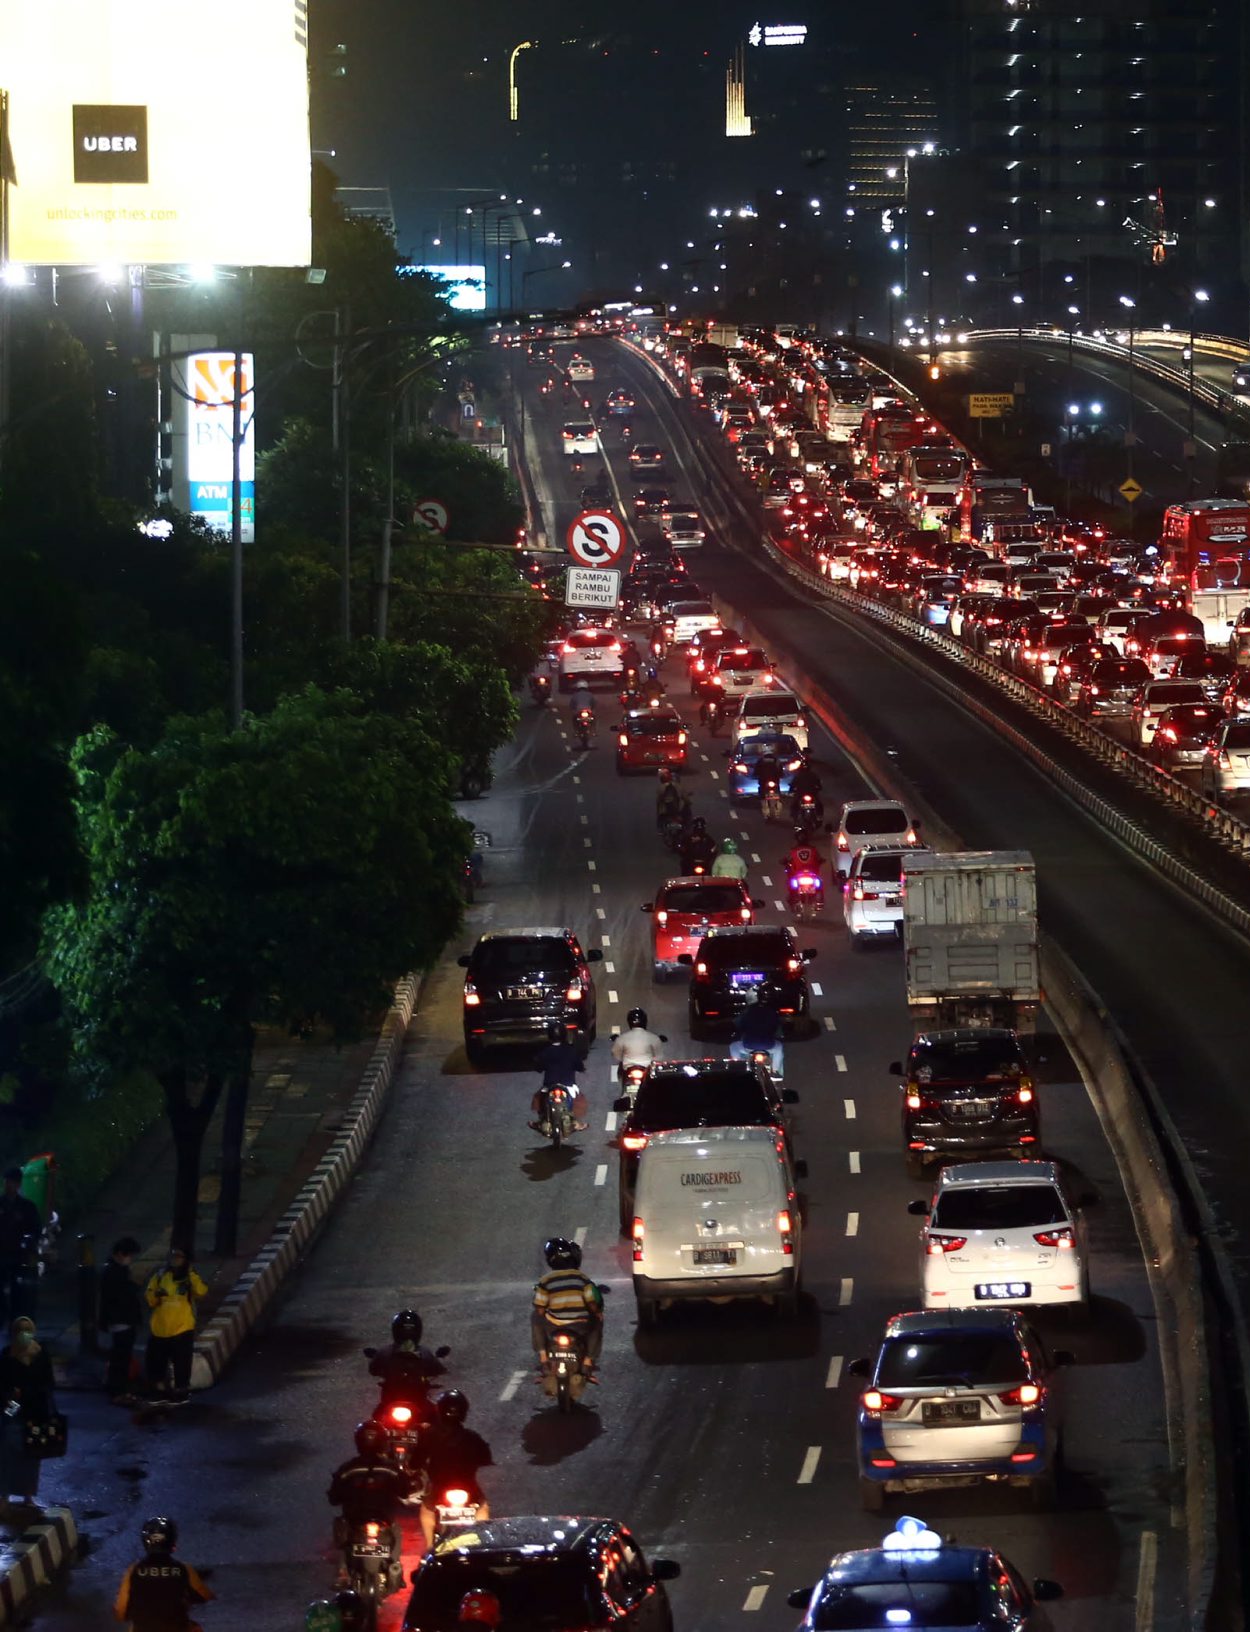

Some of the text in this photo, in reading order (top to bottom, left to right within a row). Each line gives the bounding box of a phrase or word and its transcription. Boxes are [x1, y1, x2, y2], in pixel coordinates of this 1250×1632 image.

[83, 136, 137, 152] UBER
[47, 206, 178, 223] unlockingcities.com
[197, 422, 248, 445] BNI
[197, 485, 228, 499] ATM
[575, 572, 612, 582] SAMPAI
[575, 582, 611, 593] RAMBU
[571, 592, 614, 603] BERIKUT
[680, 1171, 742, 1186] CARDIGEXPRESS
[138, 1566, 182, 1577] UBER
